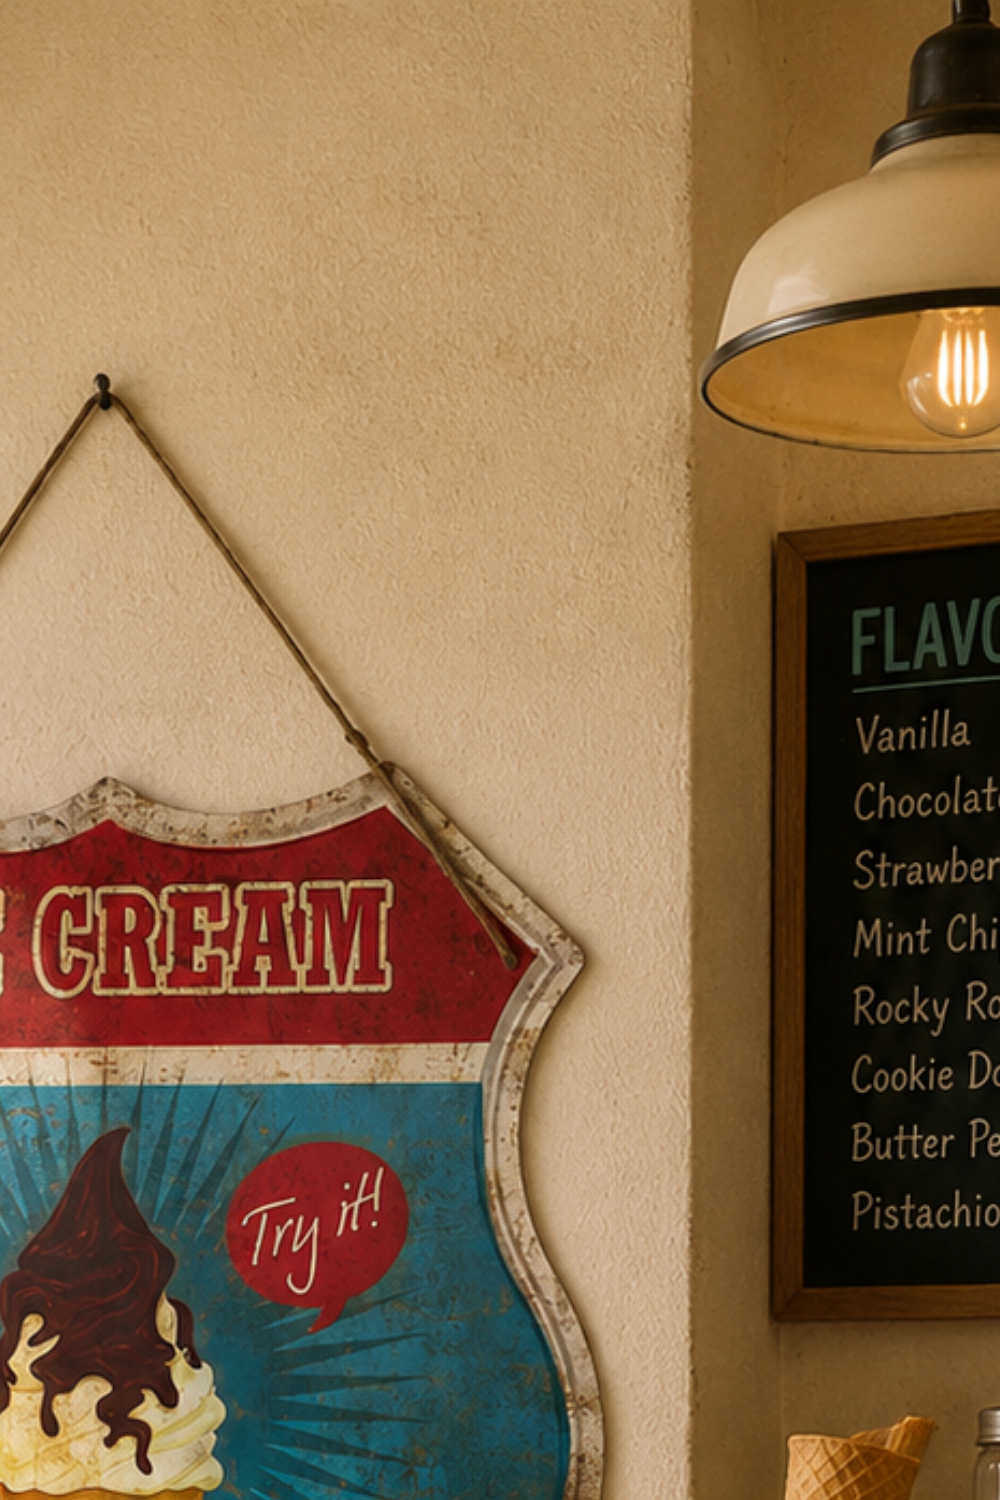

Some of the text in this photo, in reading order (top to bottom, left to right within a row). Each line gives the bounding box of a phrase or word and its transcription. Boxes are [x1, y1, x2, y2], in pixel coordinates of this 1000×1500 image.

[855, 708, 971, 754] Vanilla
[854, 775, 1000, 821] Chocolat
[853, 845, 1000, 890] Strawber
[31, 879, 393, 998] CREAM
[853, 912, 999, 957] Mint Chi
[853, 980, 1000, 1037] Rocky Ro
[852, 1053, 954, 1093] Cookie
[851, 1117, 1000, 1162] Butter Pe
[241, 1167, 384, 1295] Try it!
[852, 1189, 1000, 1231] Pistachio
